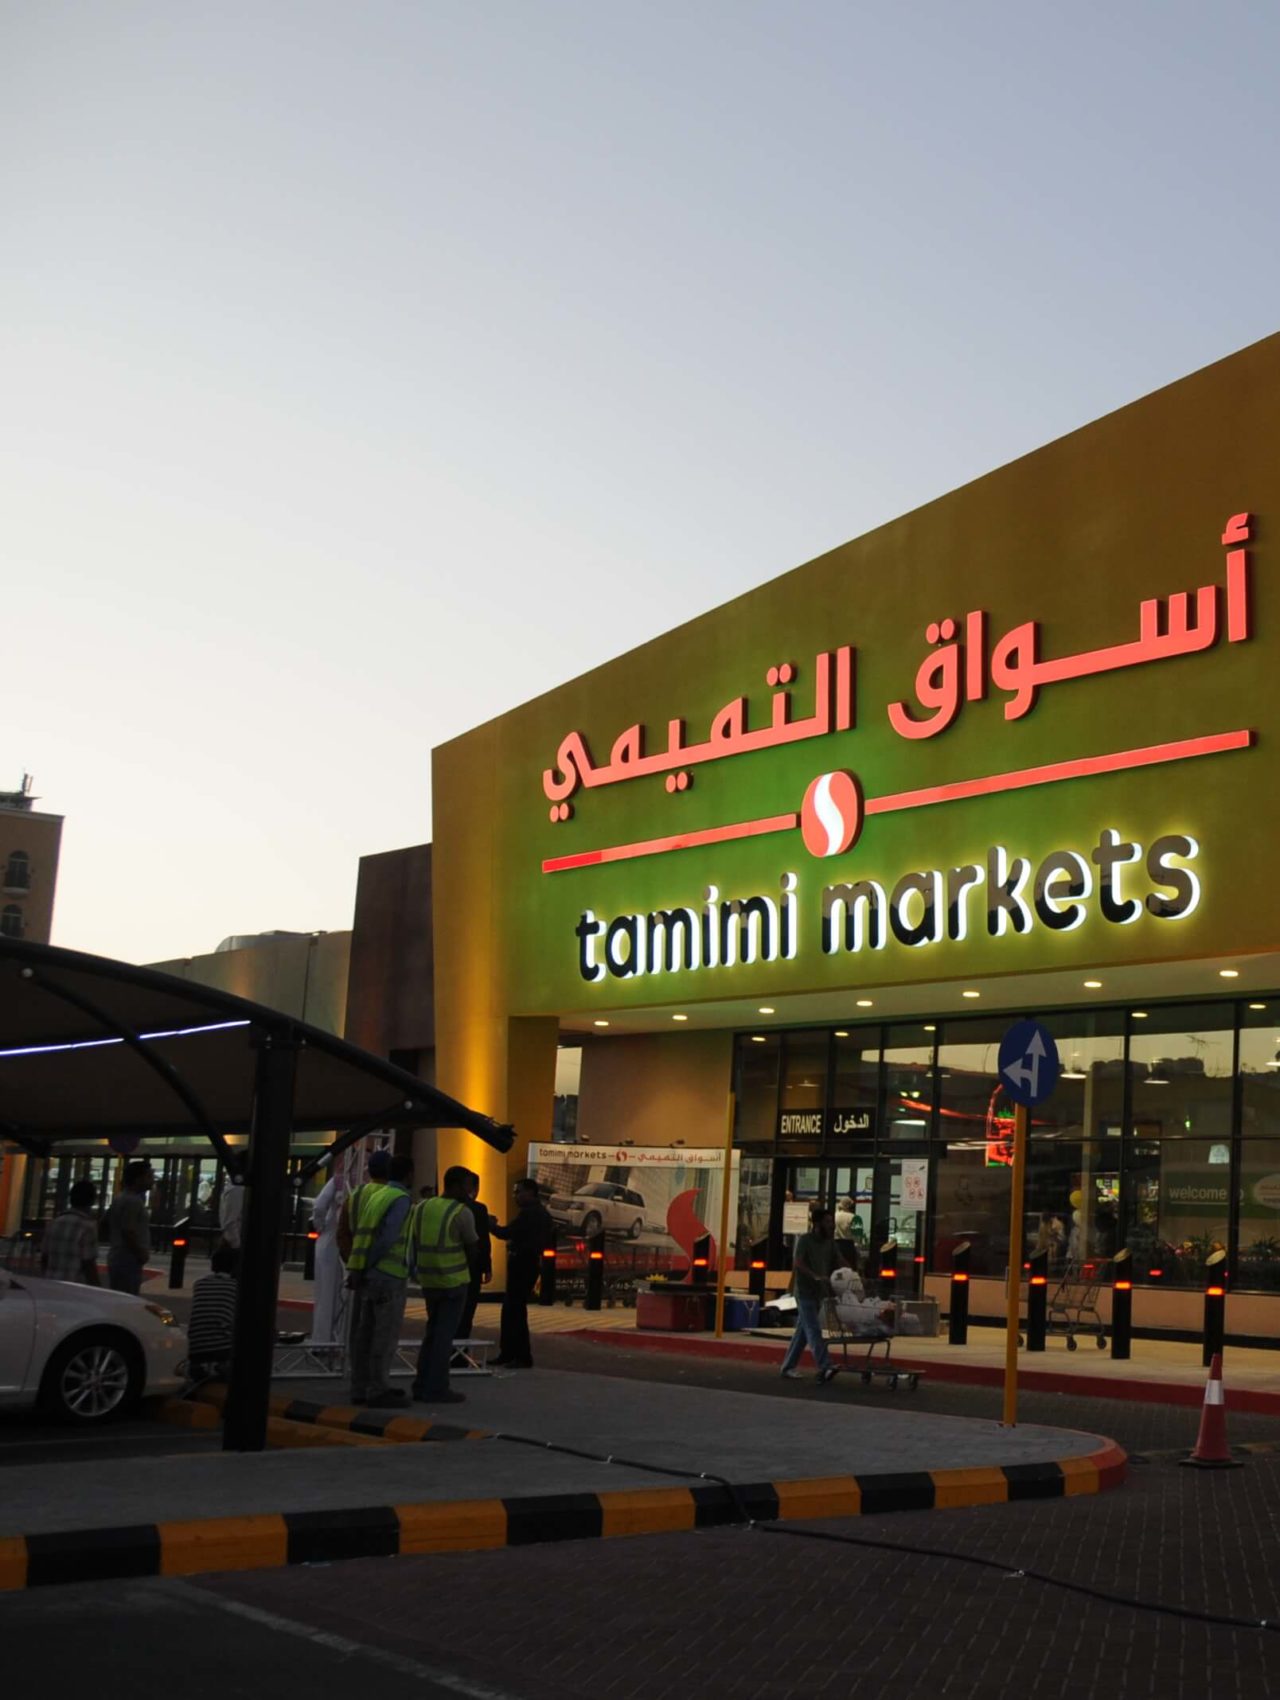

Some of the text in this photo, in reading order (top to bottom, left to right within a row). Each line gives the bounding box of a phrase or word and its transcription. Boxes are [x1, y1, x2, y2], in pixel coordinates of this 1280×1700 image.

[542, 511, 1255, 823] أسواق التميمي
[574, 826, 1202, 983] tamimi markets
[780, 1114, 822, 1134] ENTRANCE
[833, 1113, 870, 1134] الدخول
[567, 1149, 607, 1160] markets
[1168, 1185, 1228, 1200] welcome
